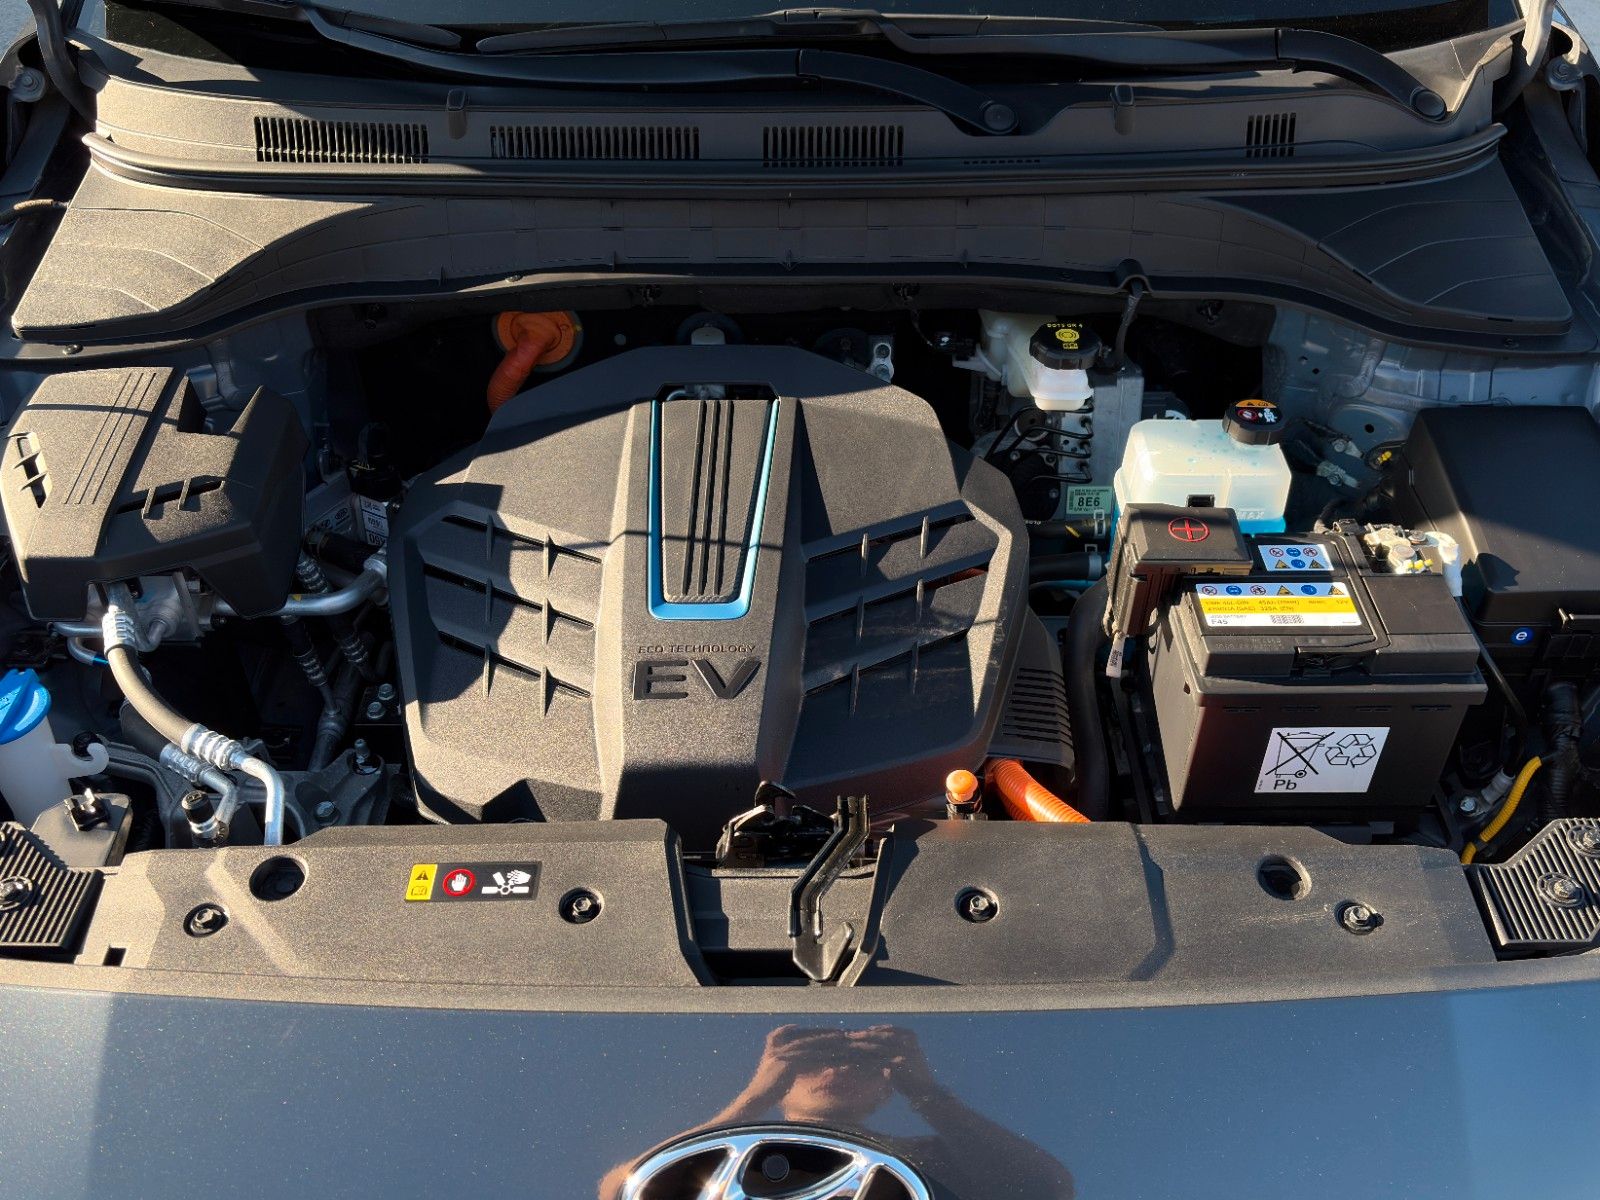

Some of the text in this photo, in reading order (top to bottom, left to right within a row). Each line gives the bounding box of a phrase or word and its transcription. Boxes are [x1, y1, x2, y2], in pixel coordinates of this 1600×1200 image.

[1078, 496, 1100, 507] 8E6
[638, 644, 756, 654] ECO TECHNOLOGY
[632, 658, 762, 699] EV
[1273, 779, 1297, 790] Pb
